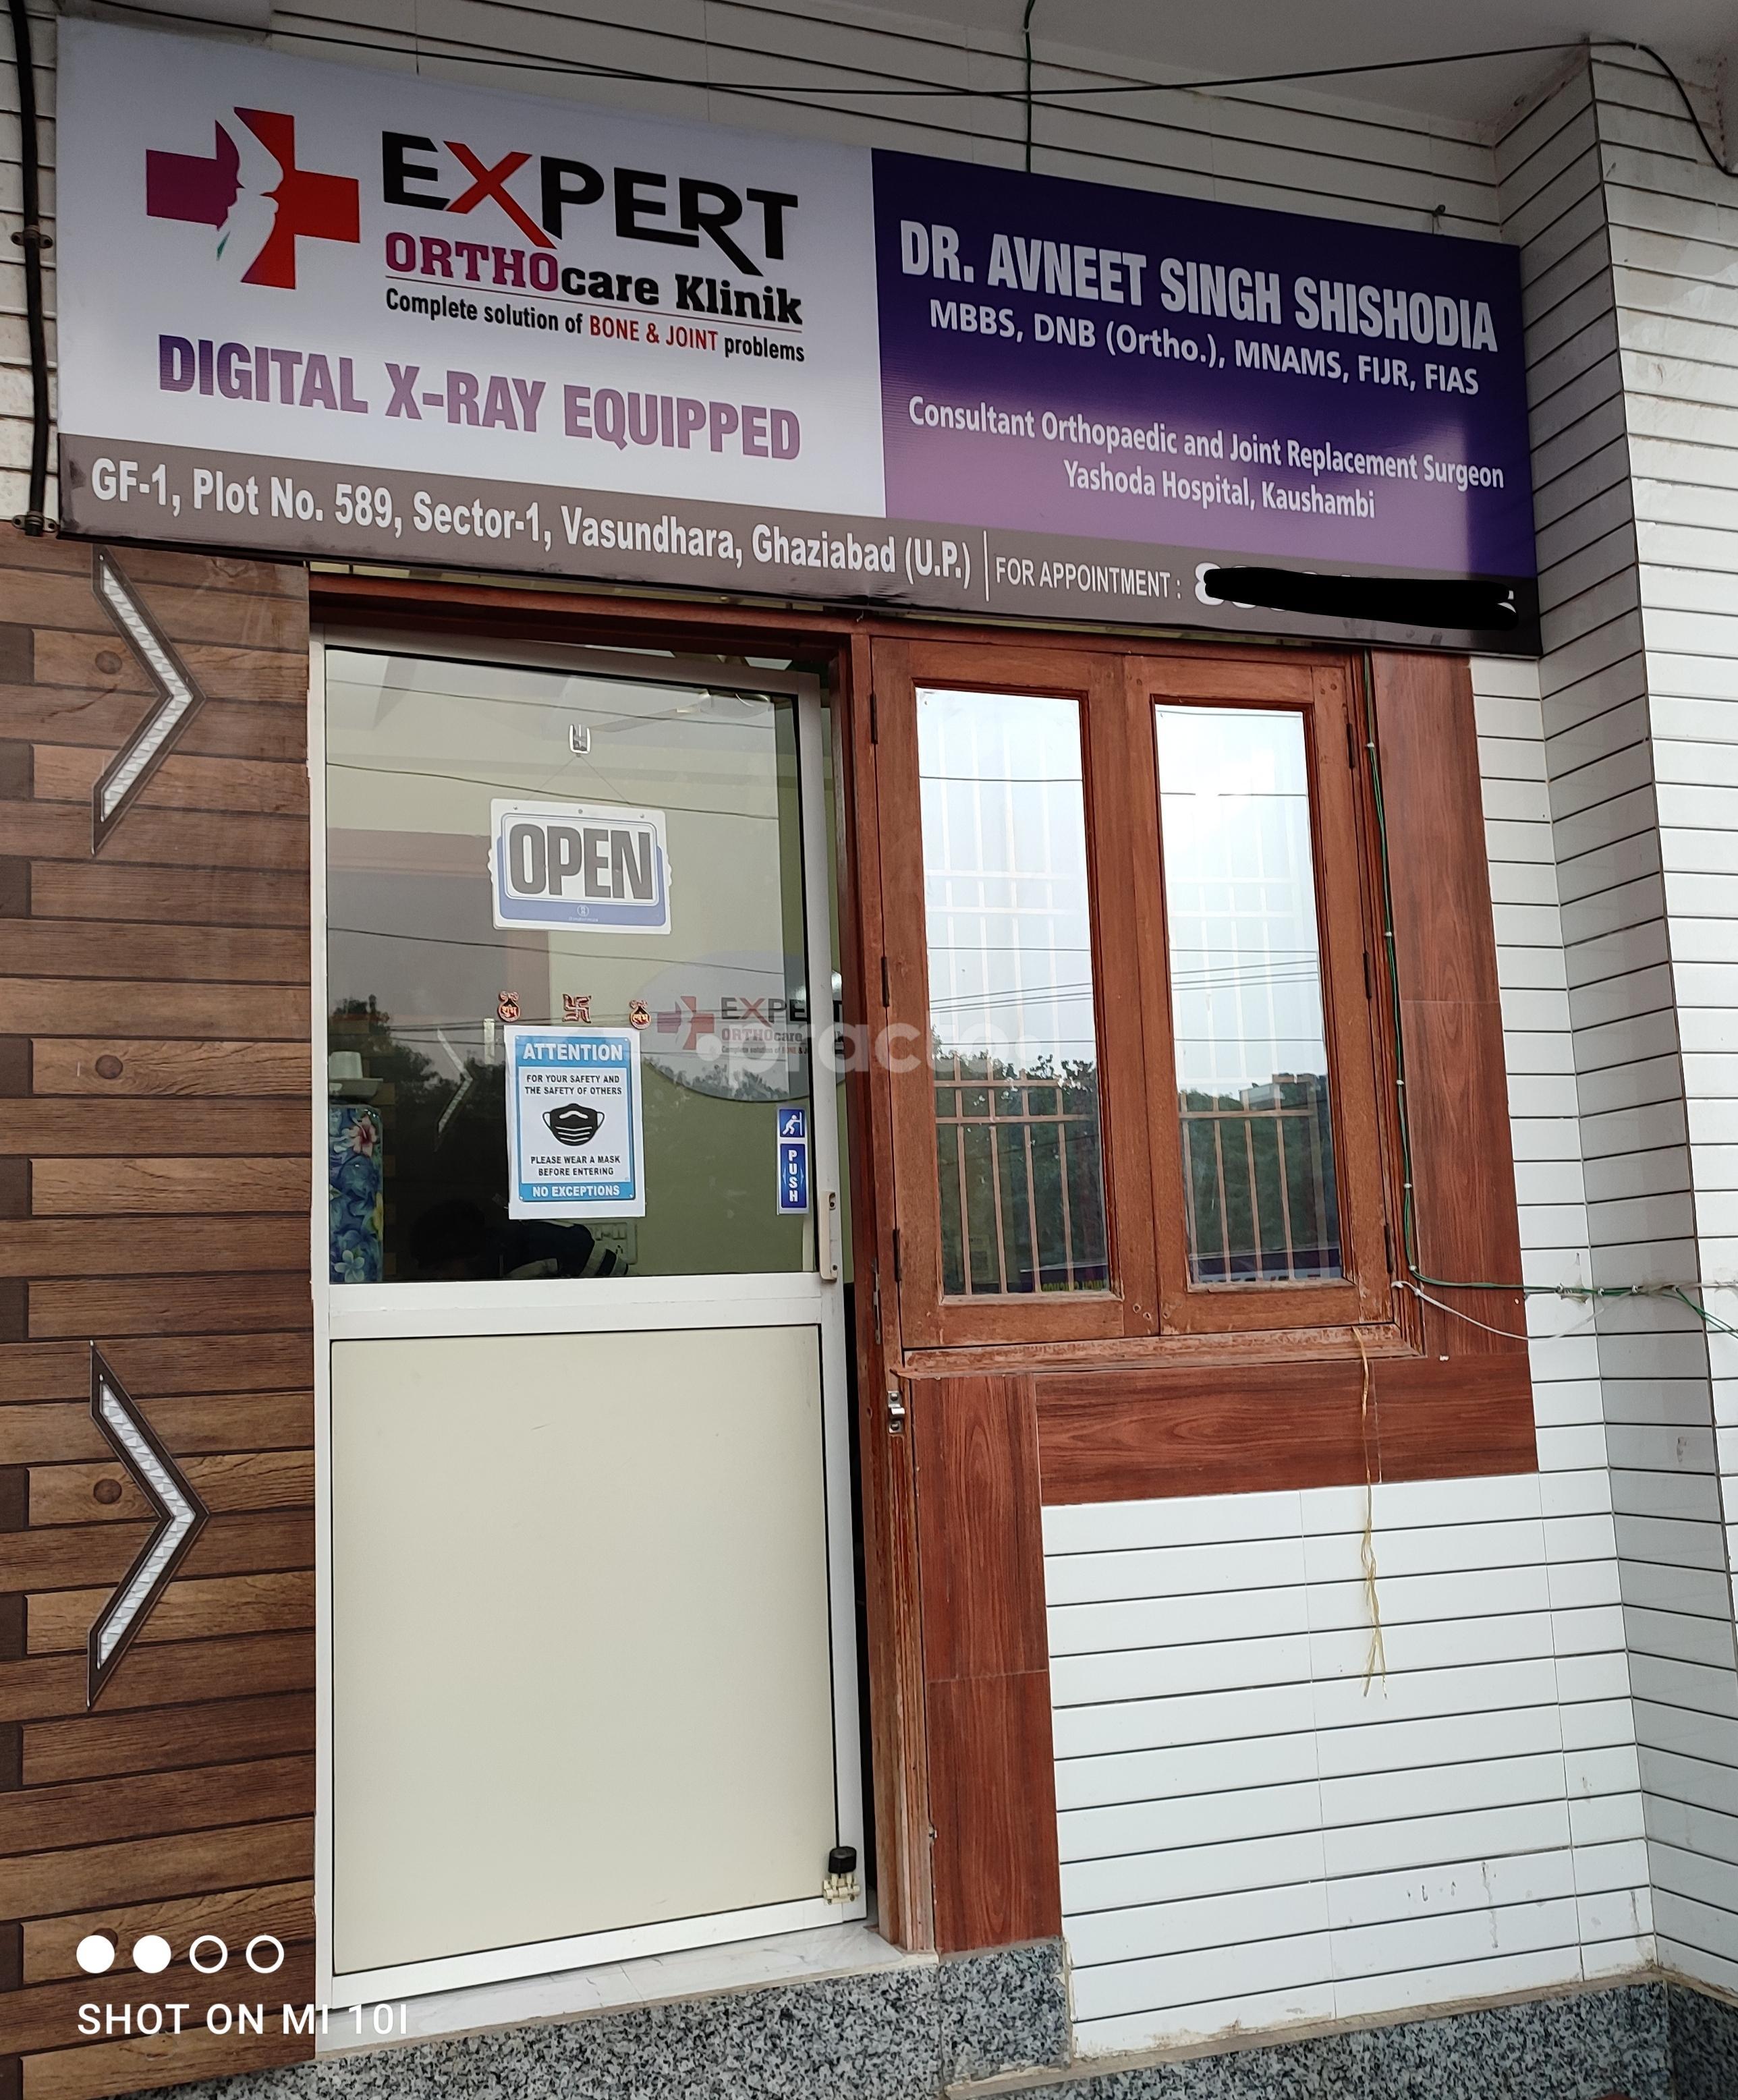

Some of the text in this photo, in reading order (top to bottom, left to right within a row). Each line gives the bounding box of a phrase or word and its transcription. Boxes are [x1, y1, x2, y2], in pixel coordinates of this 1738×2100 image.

[383, 131, 798, 277] EXPERT
[385, 231, 802, 325] ORTHOcare Klinik
[900, 220, 1498, 352] DR. AVNEET SINGH SHISHODIA
[386, 287, 806, 363] Complete solution of BONE & JOINT problems
[930, 299, 1479, 396] MBBS, DNB (Ortho.), MNAMS, FIJR, FIAS
[159, 334, 801, 461] DIGITAL X-RAY EQUIPPED
[909, 395, 1505, 492] Consultant Orthopaedic and Joint Replacement Surgeon
[1064, 459, 1376, 519] Yashoda Hospital, Kaushambi
[92, 457, 972, 590] GF-1, Plot No. 589, Sector-1, Vasundhara, Ghaziabad (U.P.)
[996, 556, 1036, 588] FOR
[1040, 559, 1171, 598] APPOINTMENT
[509, 823, 654, 900] OPEN
[522, 1042, 623, 1062] ATTENTION
[526, 1074, 620, 1083] FOR YOUR SAFETY AND
[524, 1086, 622, 1095] THE SAFETY OF OTHERS
[530, 1156, 561, 1164] PLEASE
[564, 1156, 587, 1164] WEAR
[597, 1155, 621, 1164] MASK
[532, 1185, 621, 1197] NO EXCEPTIONS
[538, 1167, 614, 1176] BEFORE ENTERING
[787, 1149, 799, 1202] PUSH
